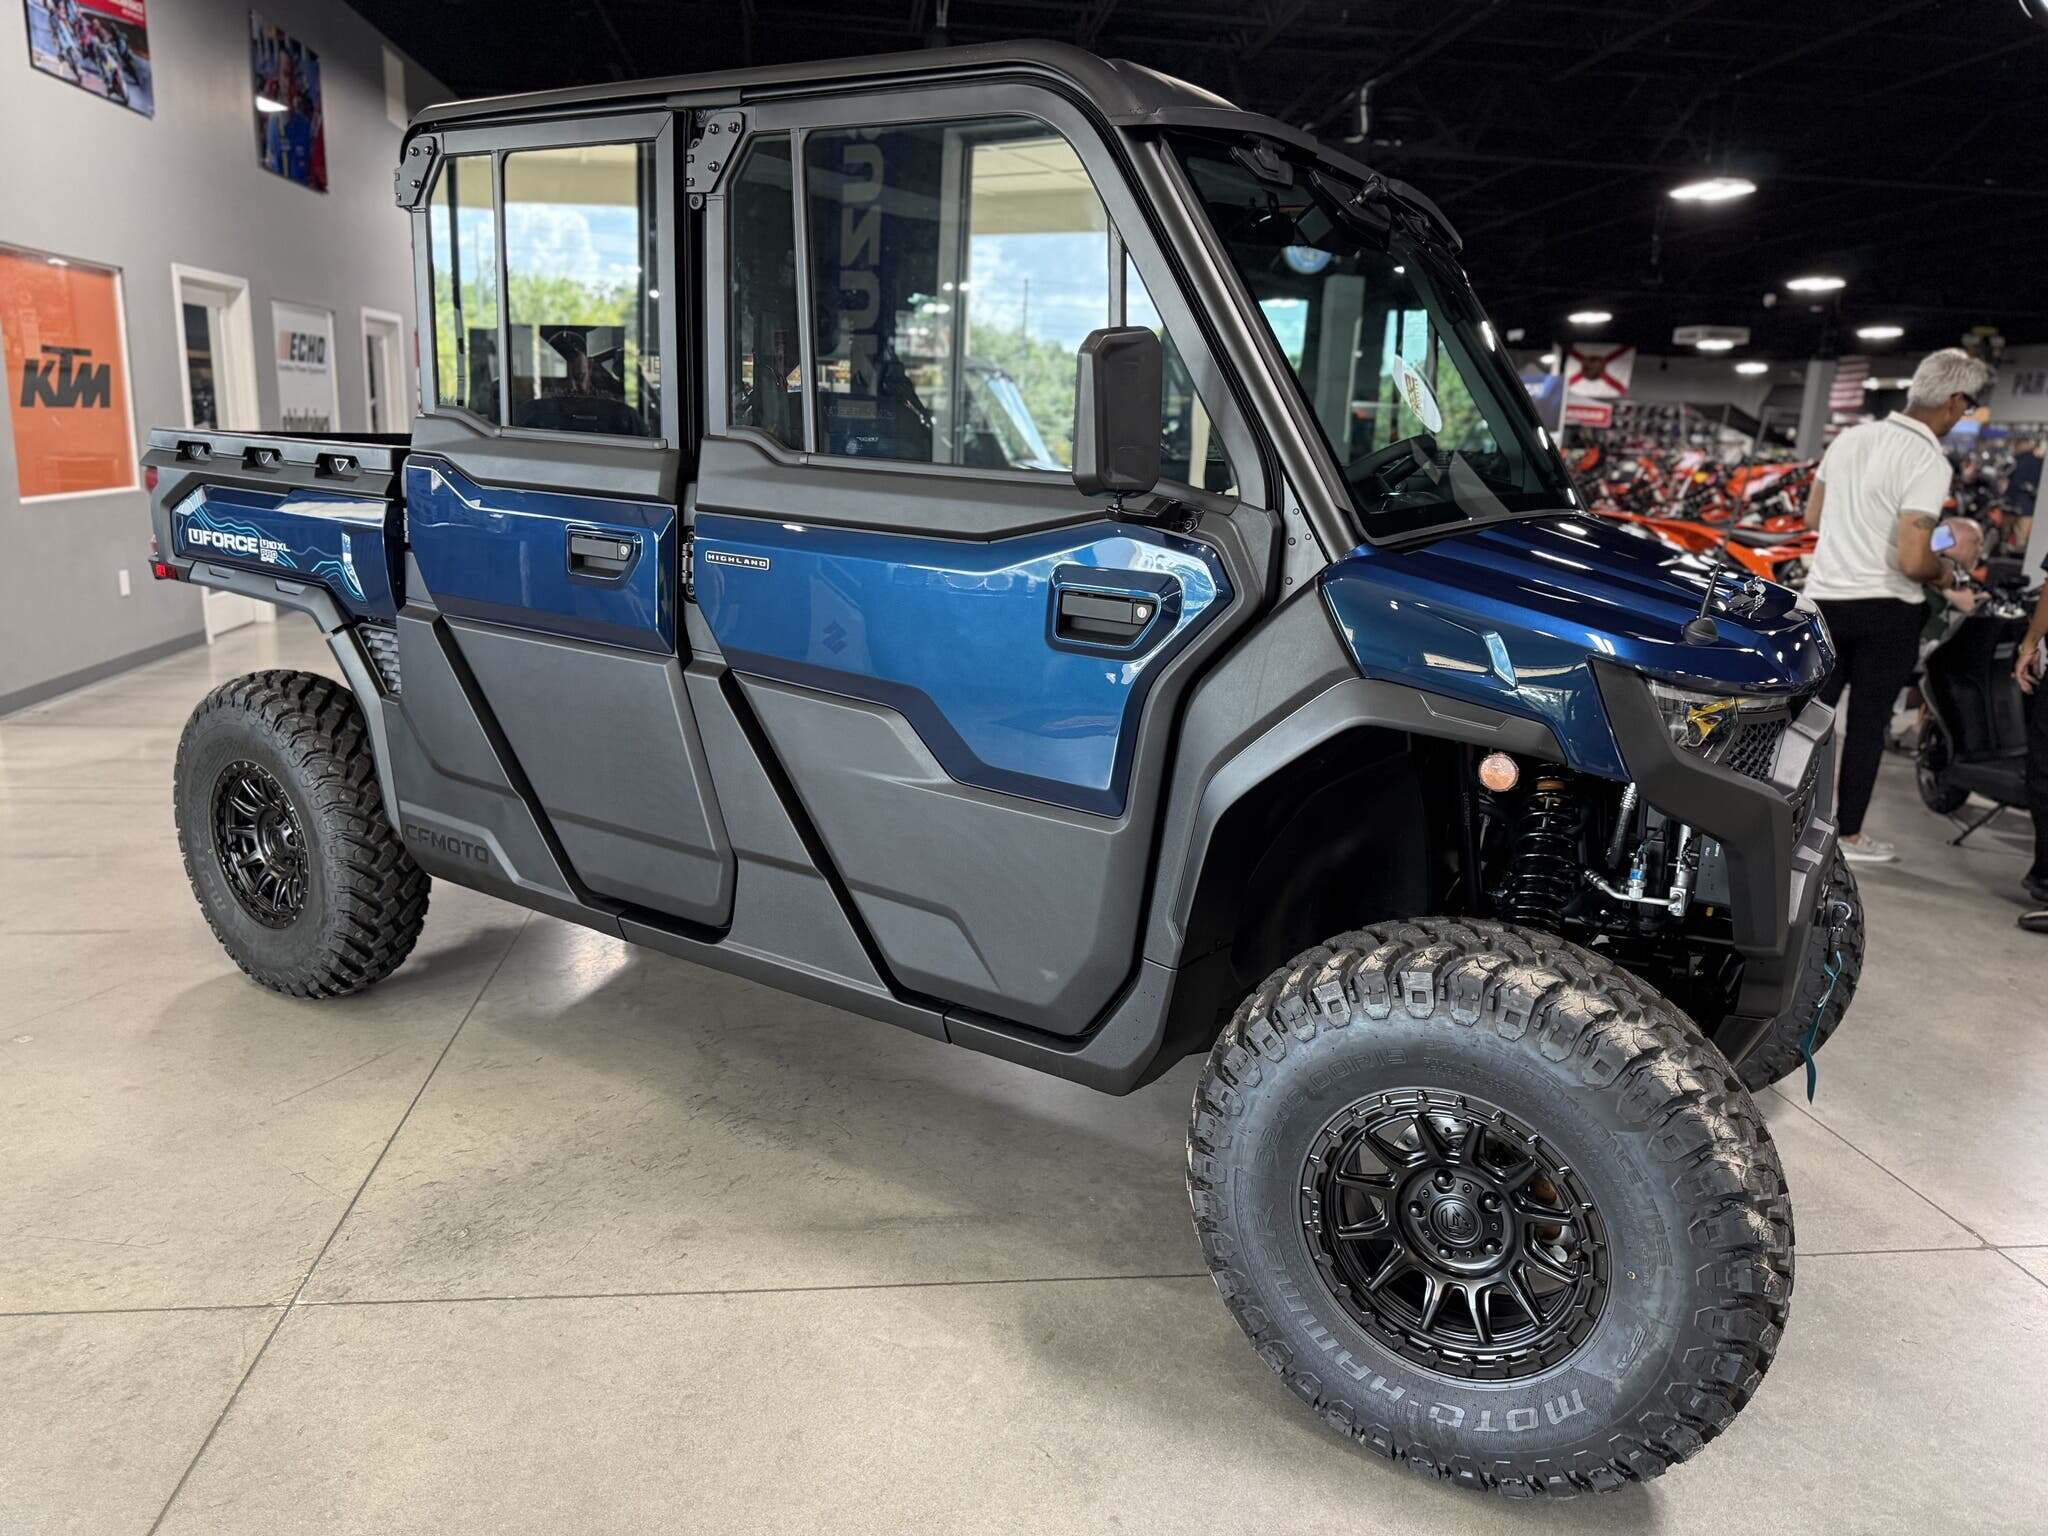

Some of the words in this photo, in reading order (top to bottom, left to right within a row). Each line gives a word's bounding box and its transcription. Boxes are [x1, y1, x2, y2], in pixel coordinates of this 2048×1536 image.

[290, 331, 326, 365] ECHO
[20, 345, 111, 408] KTM
[188, 528, 259, 554] UFORCE
[708, 553, 767, 568] HIGHLAND
[405, 823, 490, 865] CFMOTO
